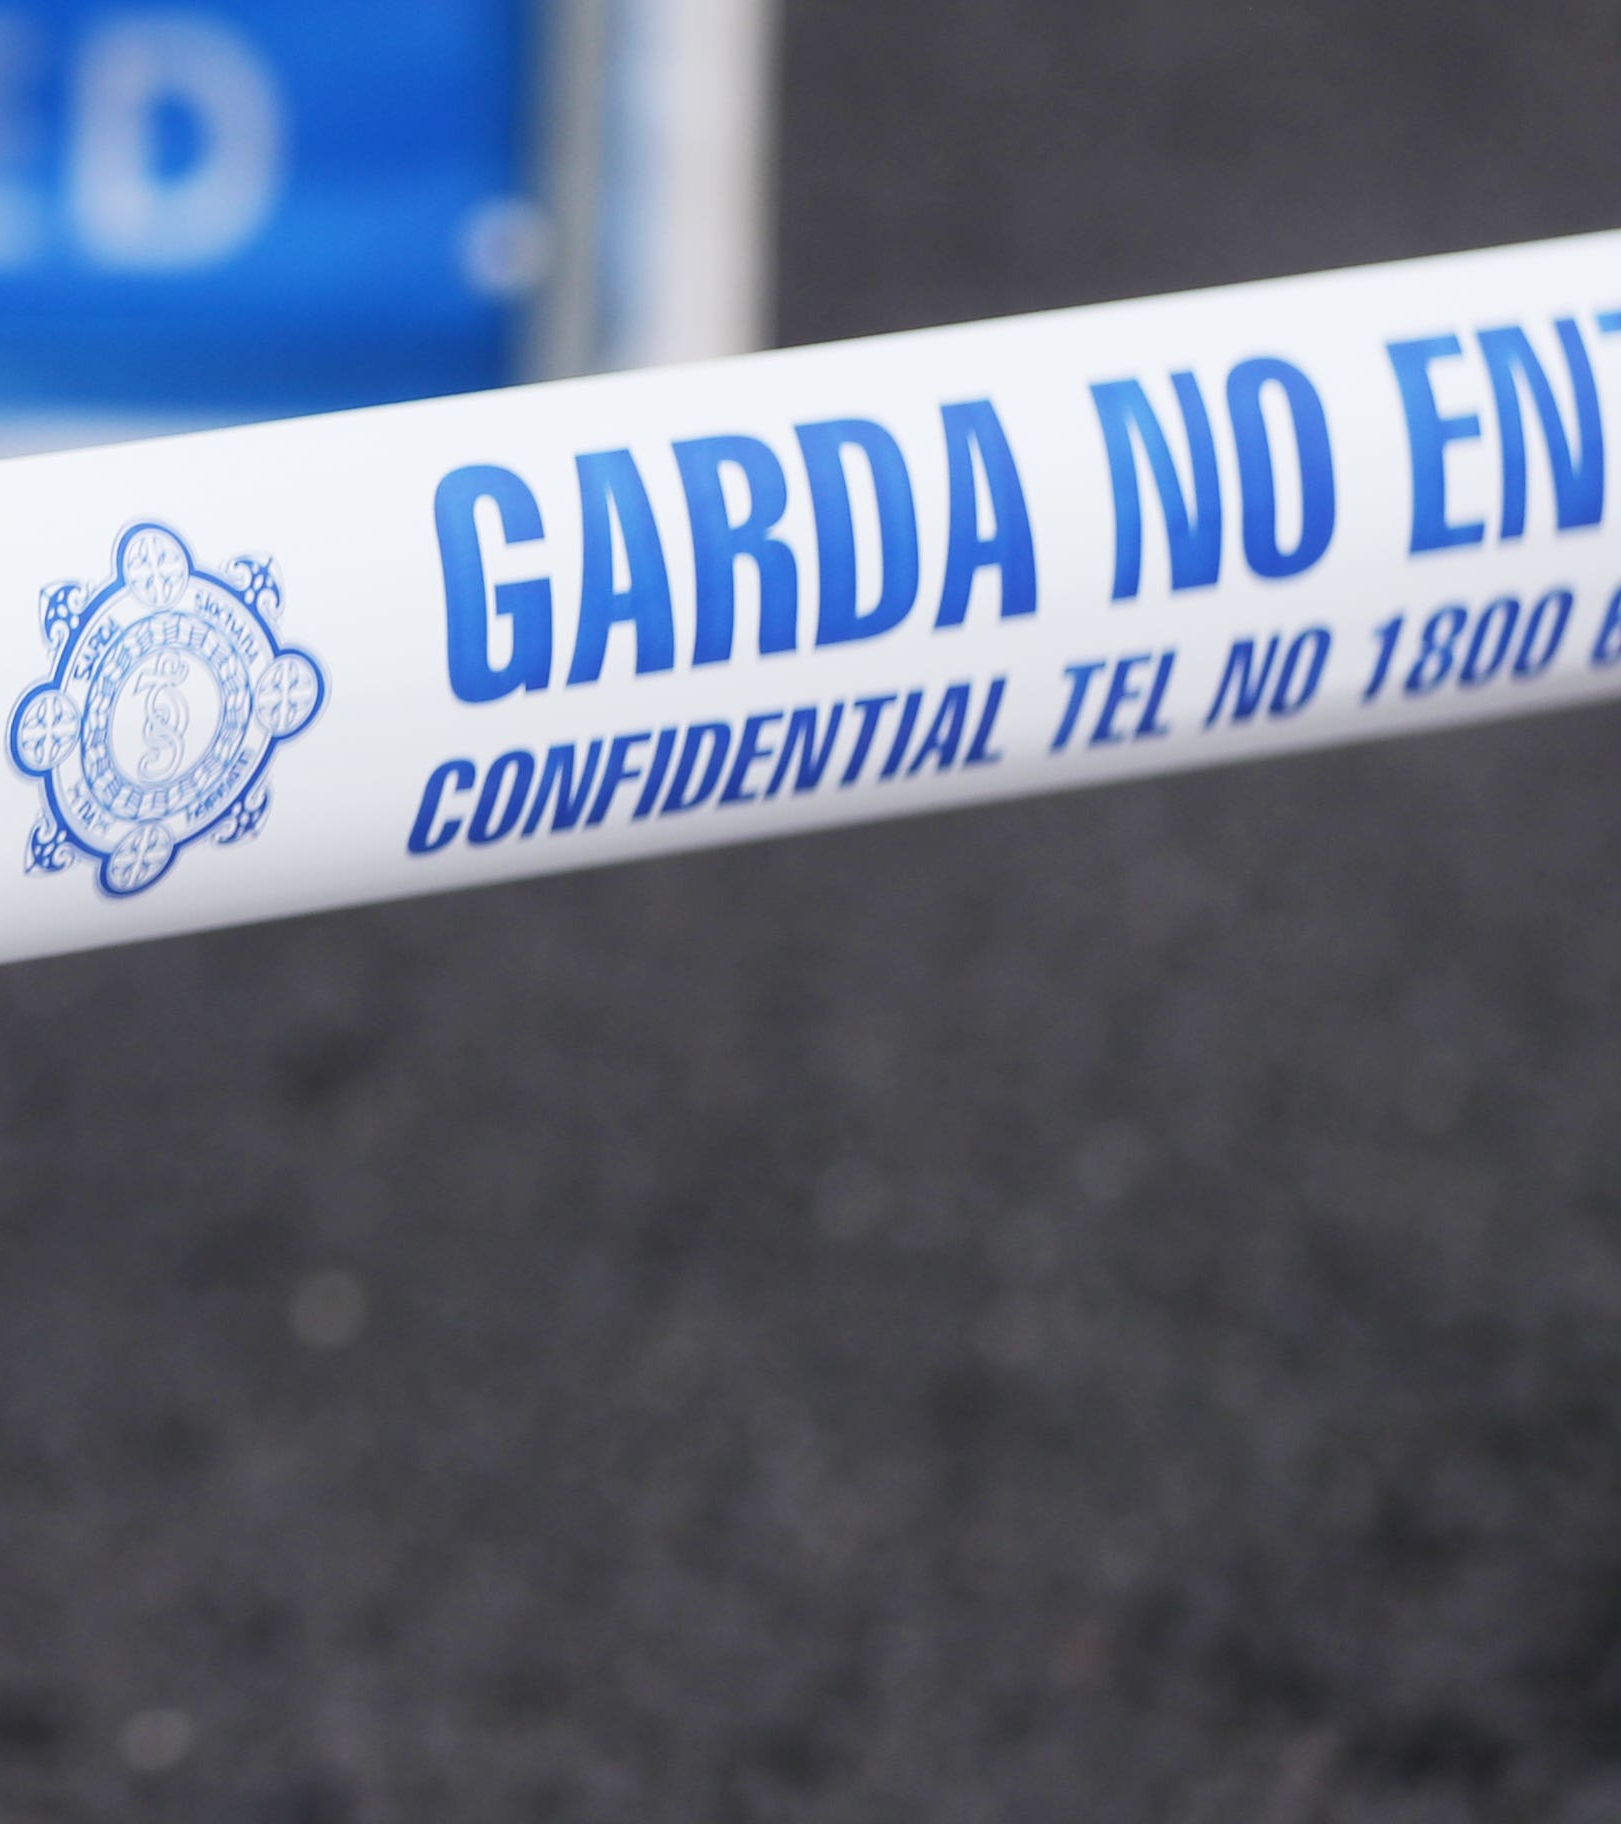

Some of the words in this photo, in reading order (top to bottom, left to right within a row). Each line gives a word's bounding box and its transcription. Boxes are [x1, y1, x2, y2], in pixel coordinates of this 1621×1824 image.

[434, 399, 1038, 705] GARDA
[1089, 356, 1337, 602] NO
[1386, 310, 1621, 556] EN
[406, 677, 1006, 856] CONFIDENTIAL
[1051, 650, 1177, 751] TEL
[1205, 626, 1333, 726] NO
[1364, 588, 1574, 700] 1800
